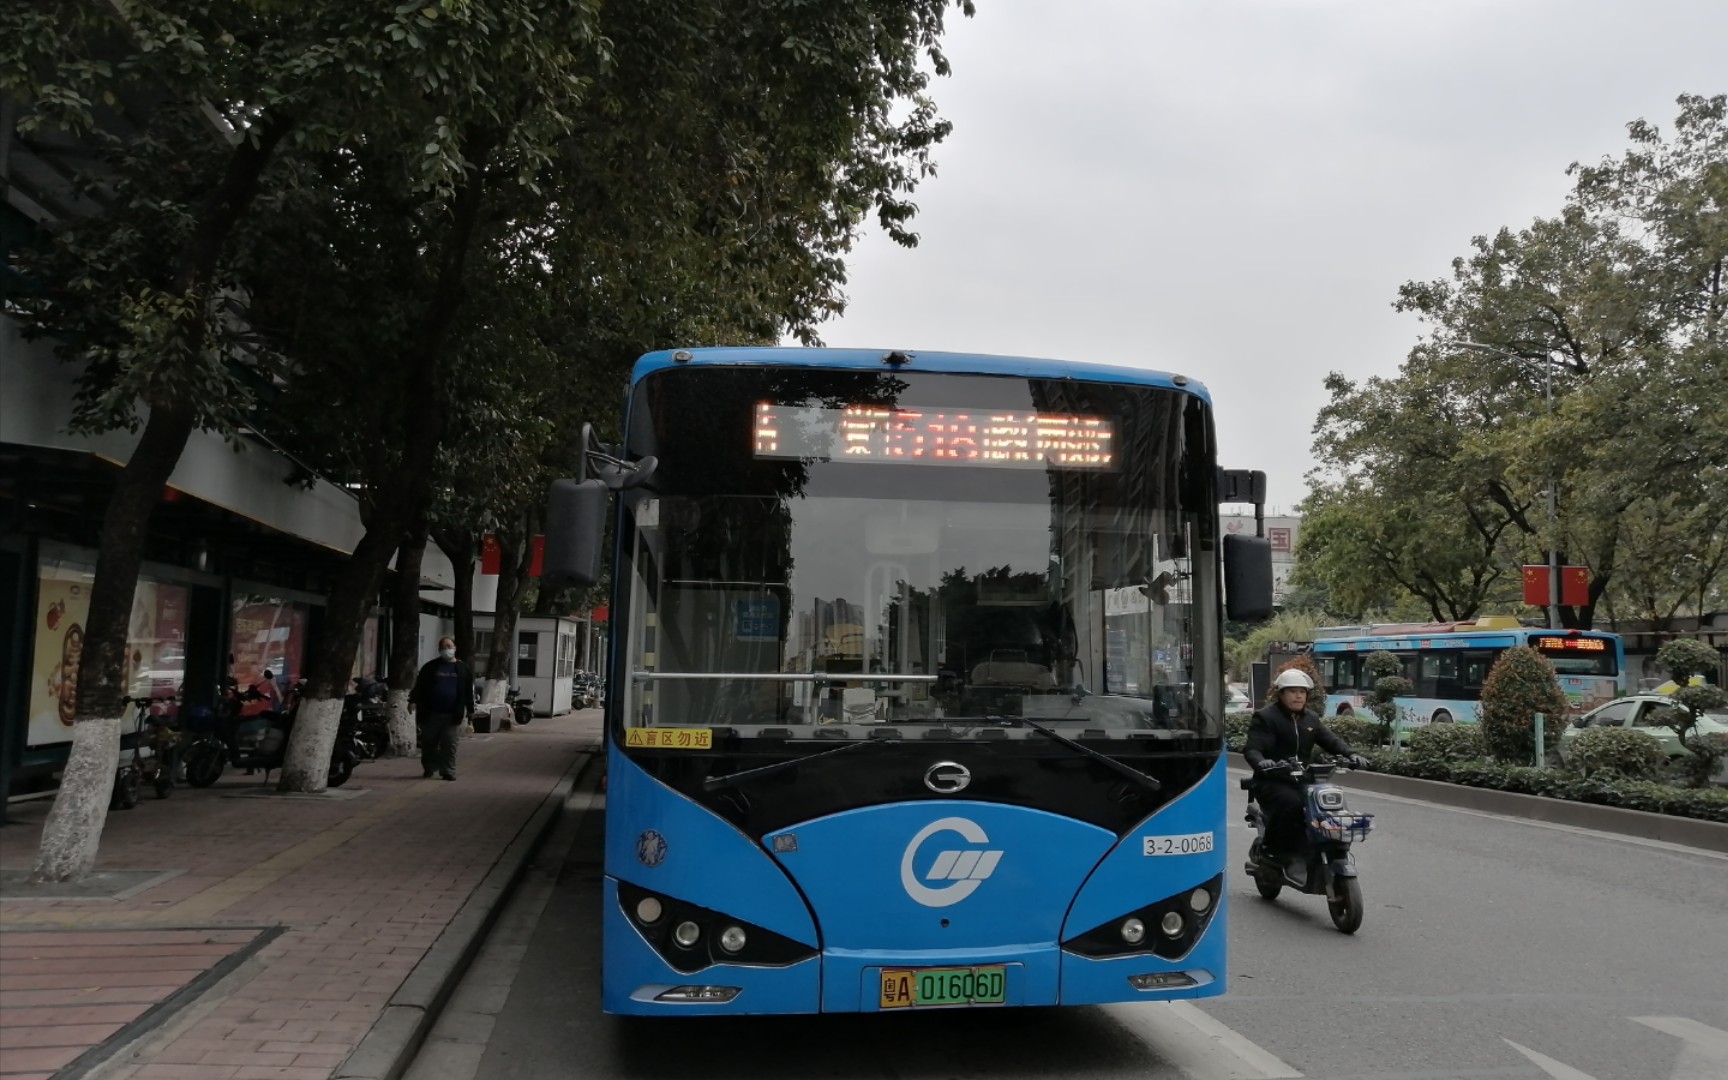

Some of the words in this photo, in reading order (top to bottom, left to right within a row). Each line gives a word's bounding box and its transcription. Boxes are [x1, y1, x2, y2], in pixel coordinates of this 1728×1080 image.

[645, 731, 708, 746] 盲区勿近
[1146, 835, 1212, 855] 3-2-0068
